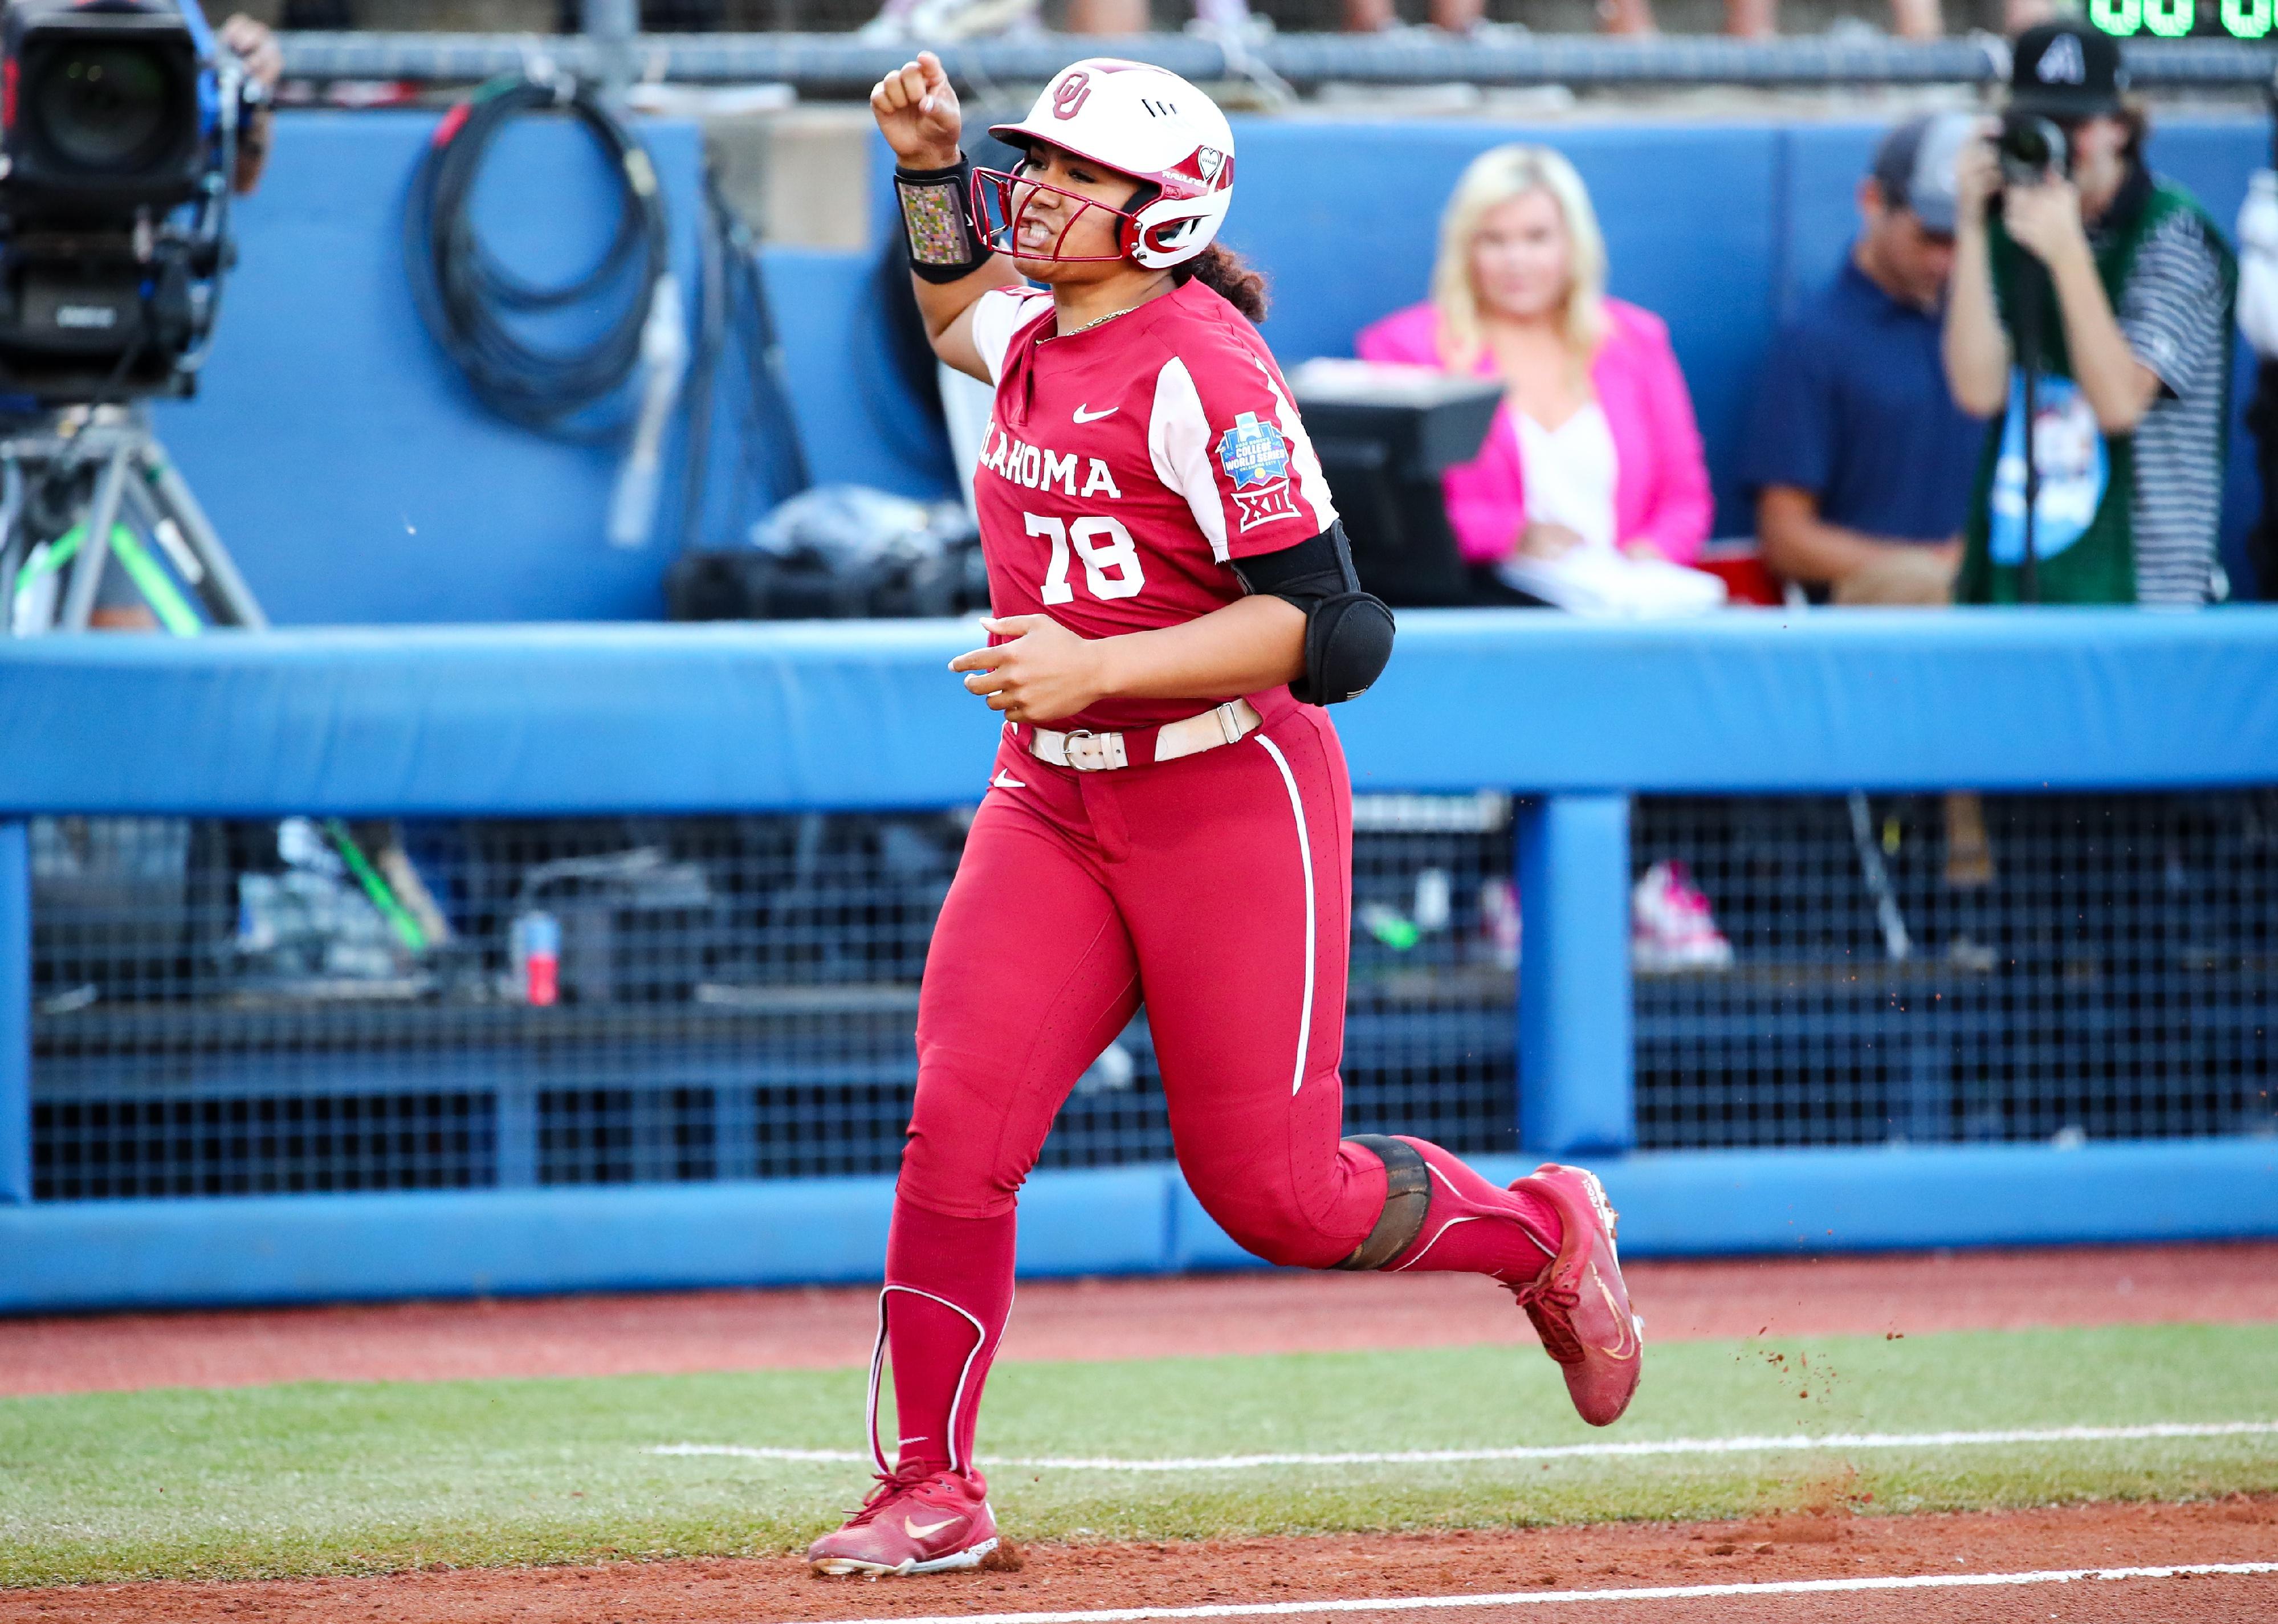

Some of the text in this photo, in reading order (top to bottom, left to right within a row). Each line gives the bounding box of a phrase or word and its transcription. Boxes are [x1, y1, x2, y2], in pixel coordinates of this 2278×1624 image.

[1053, 71, 1091, 121] OU
[979, 411, 1122, 499] LAHOMA
[1225, 448, 1285, 471] WORLD SERIES
[1236, 441, 1273, 458] COLLEGE
[1024, 511, 1146, 606] 78
